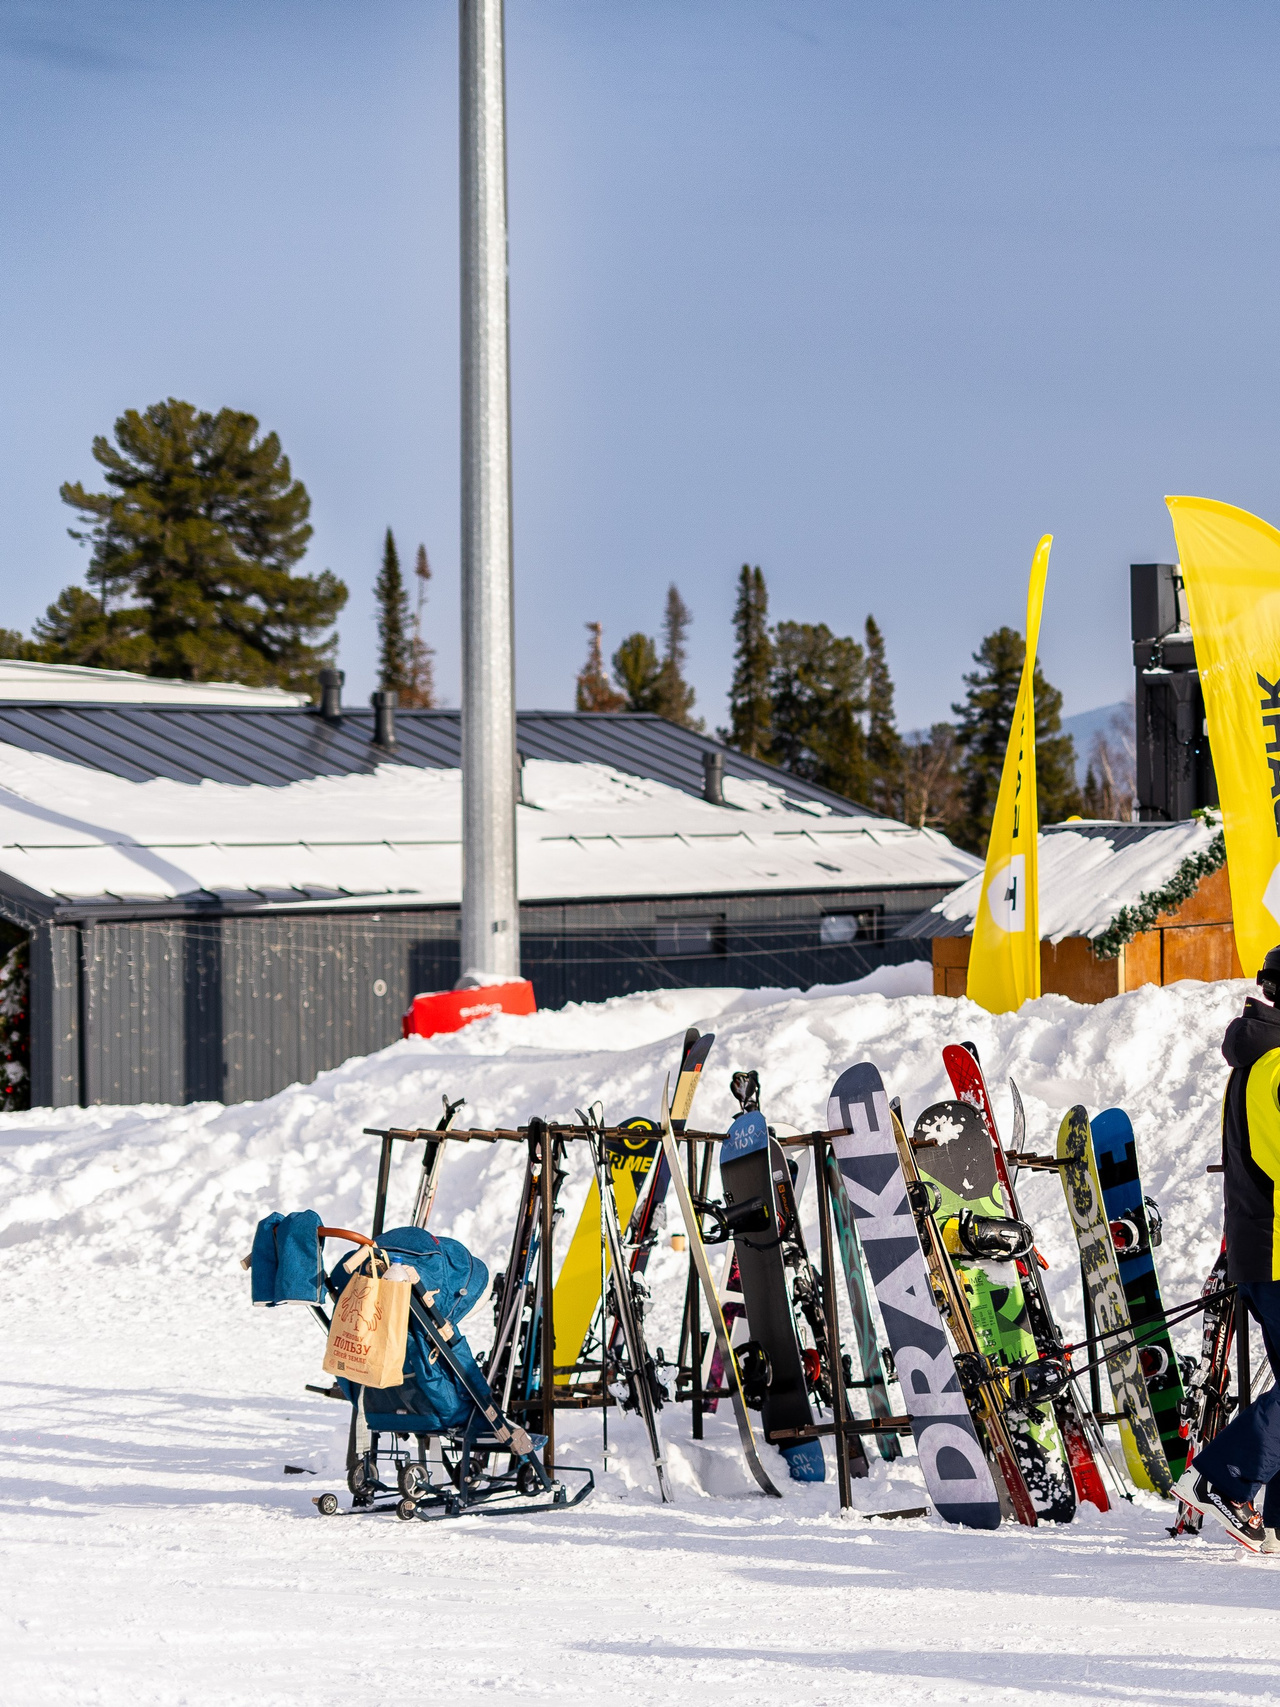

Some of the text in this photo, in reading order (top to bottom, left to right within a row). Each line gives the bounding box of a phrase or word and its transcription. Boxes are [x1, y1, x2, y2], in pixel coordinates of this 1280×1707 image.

[828, 1091, 999, 1503] DRAKE
[333, 1336, 372, 1356] ПОЛЬЗУ
[1214, 1321, 1227, 1374] ATOMIC
[1207, 1491, 1244, 1530] NORDICA
